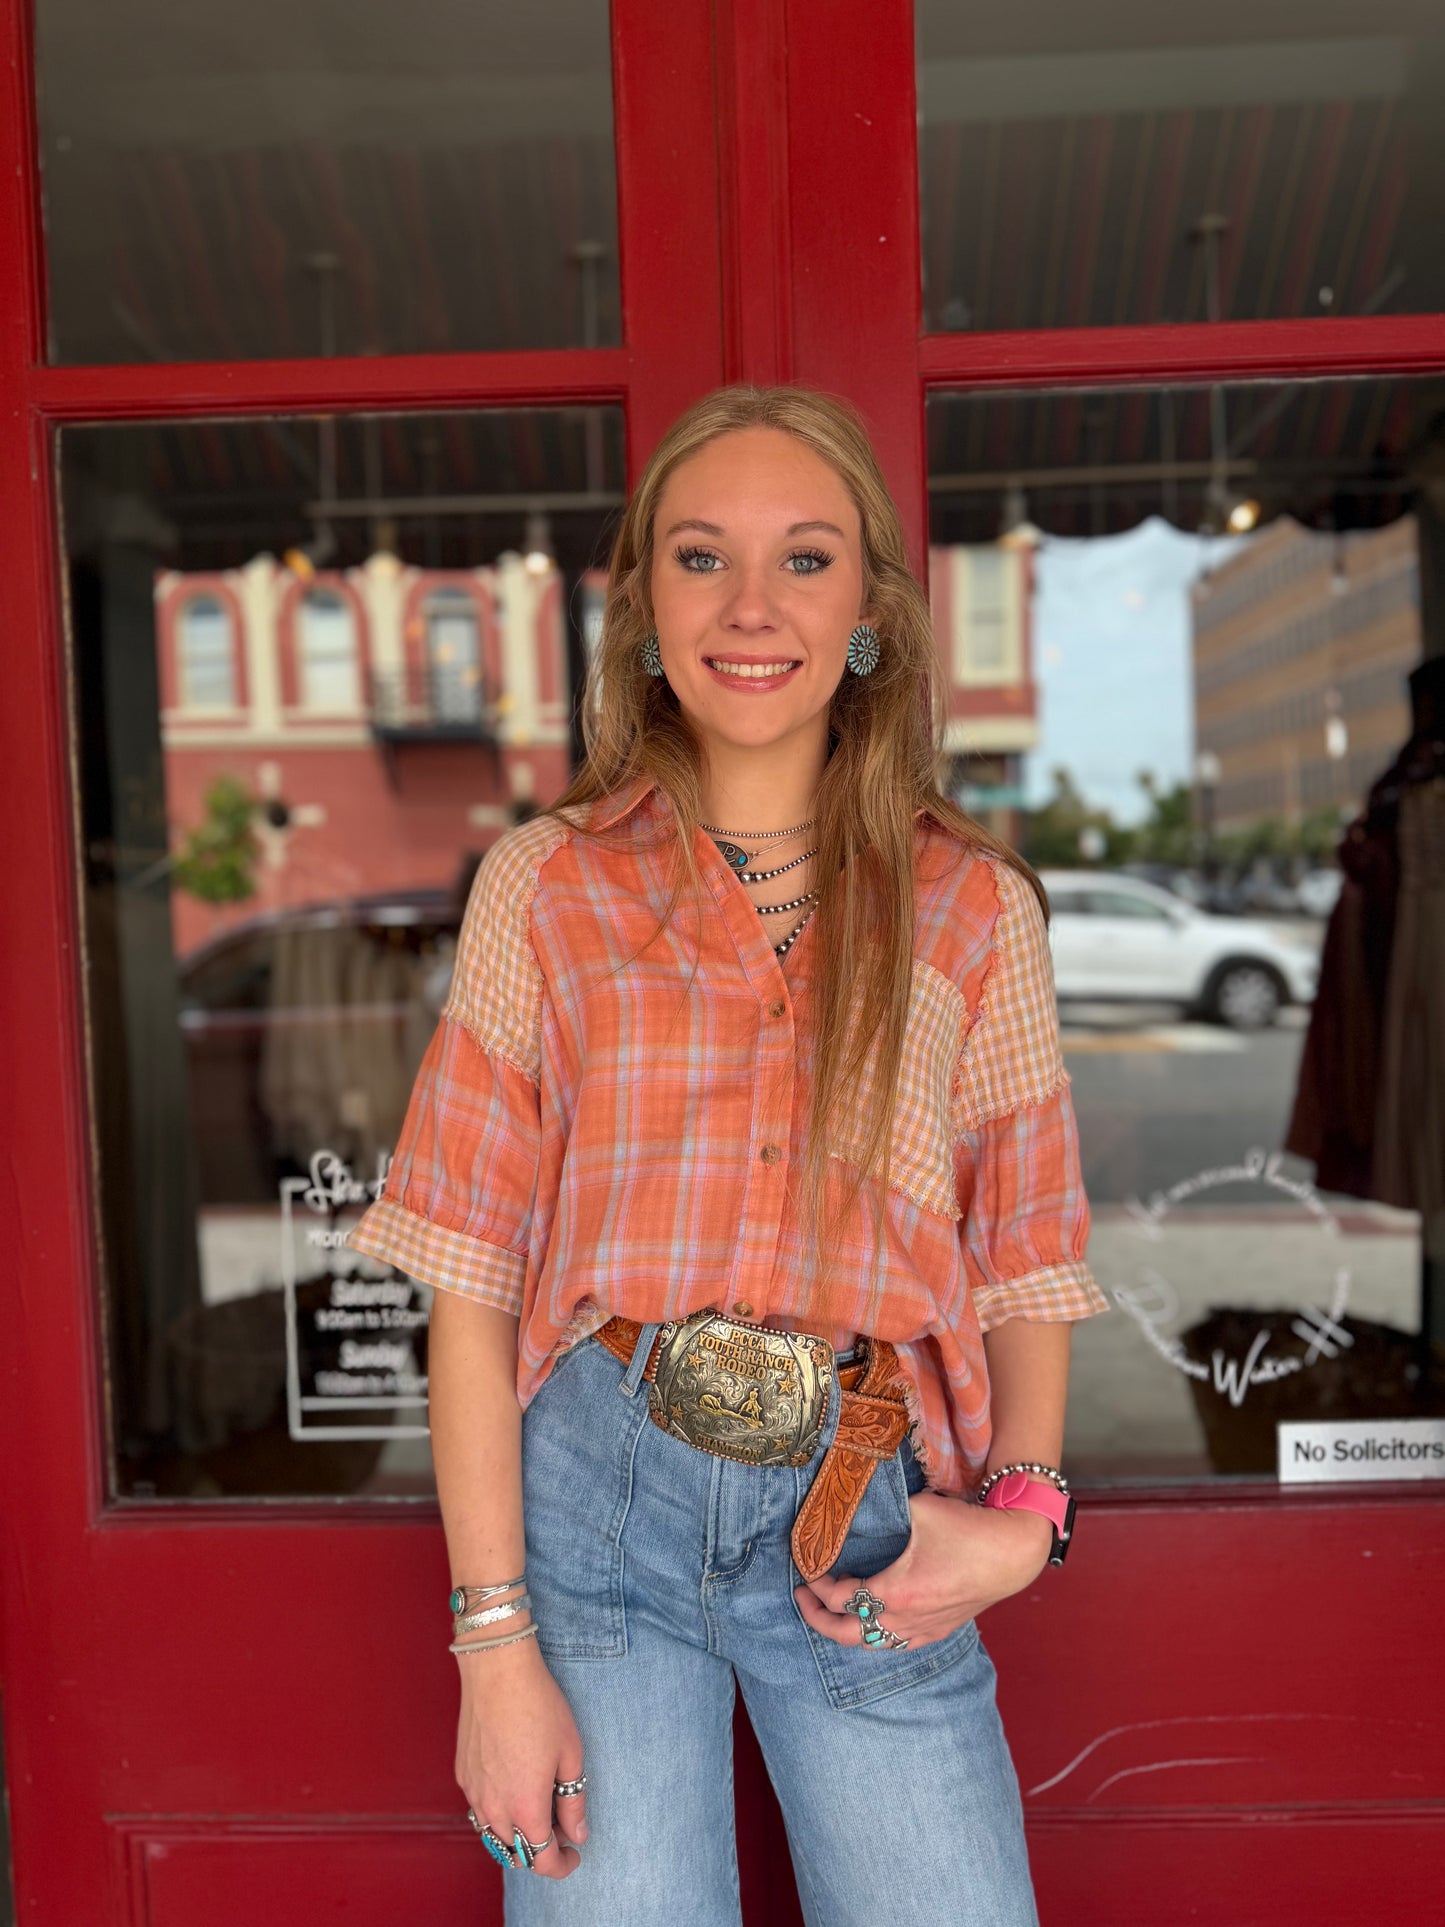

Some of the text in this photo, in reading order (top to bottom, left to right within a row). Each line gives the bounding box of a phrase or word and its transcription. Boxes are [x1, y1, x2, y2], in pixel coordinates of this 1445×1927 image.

[699, 1332, 795, 1372] YOUTH RANCH
[730, 1330, 765, 1351] PCCA
[717, 1355, 767, 1381] RODEO
[694, 1433, 761, 1460] CHAMPION
[1294, 1438, 1445, 1462] No Solicitors
